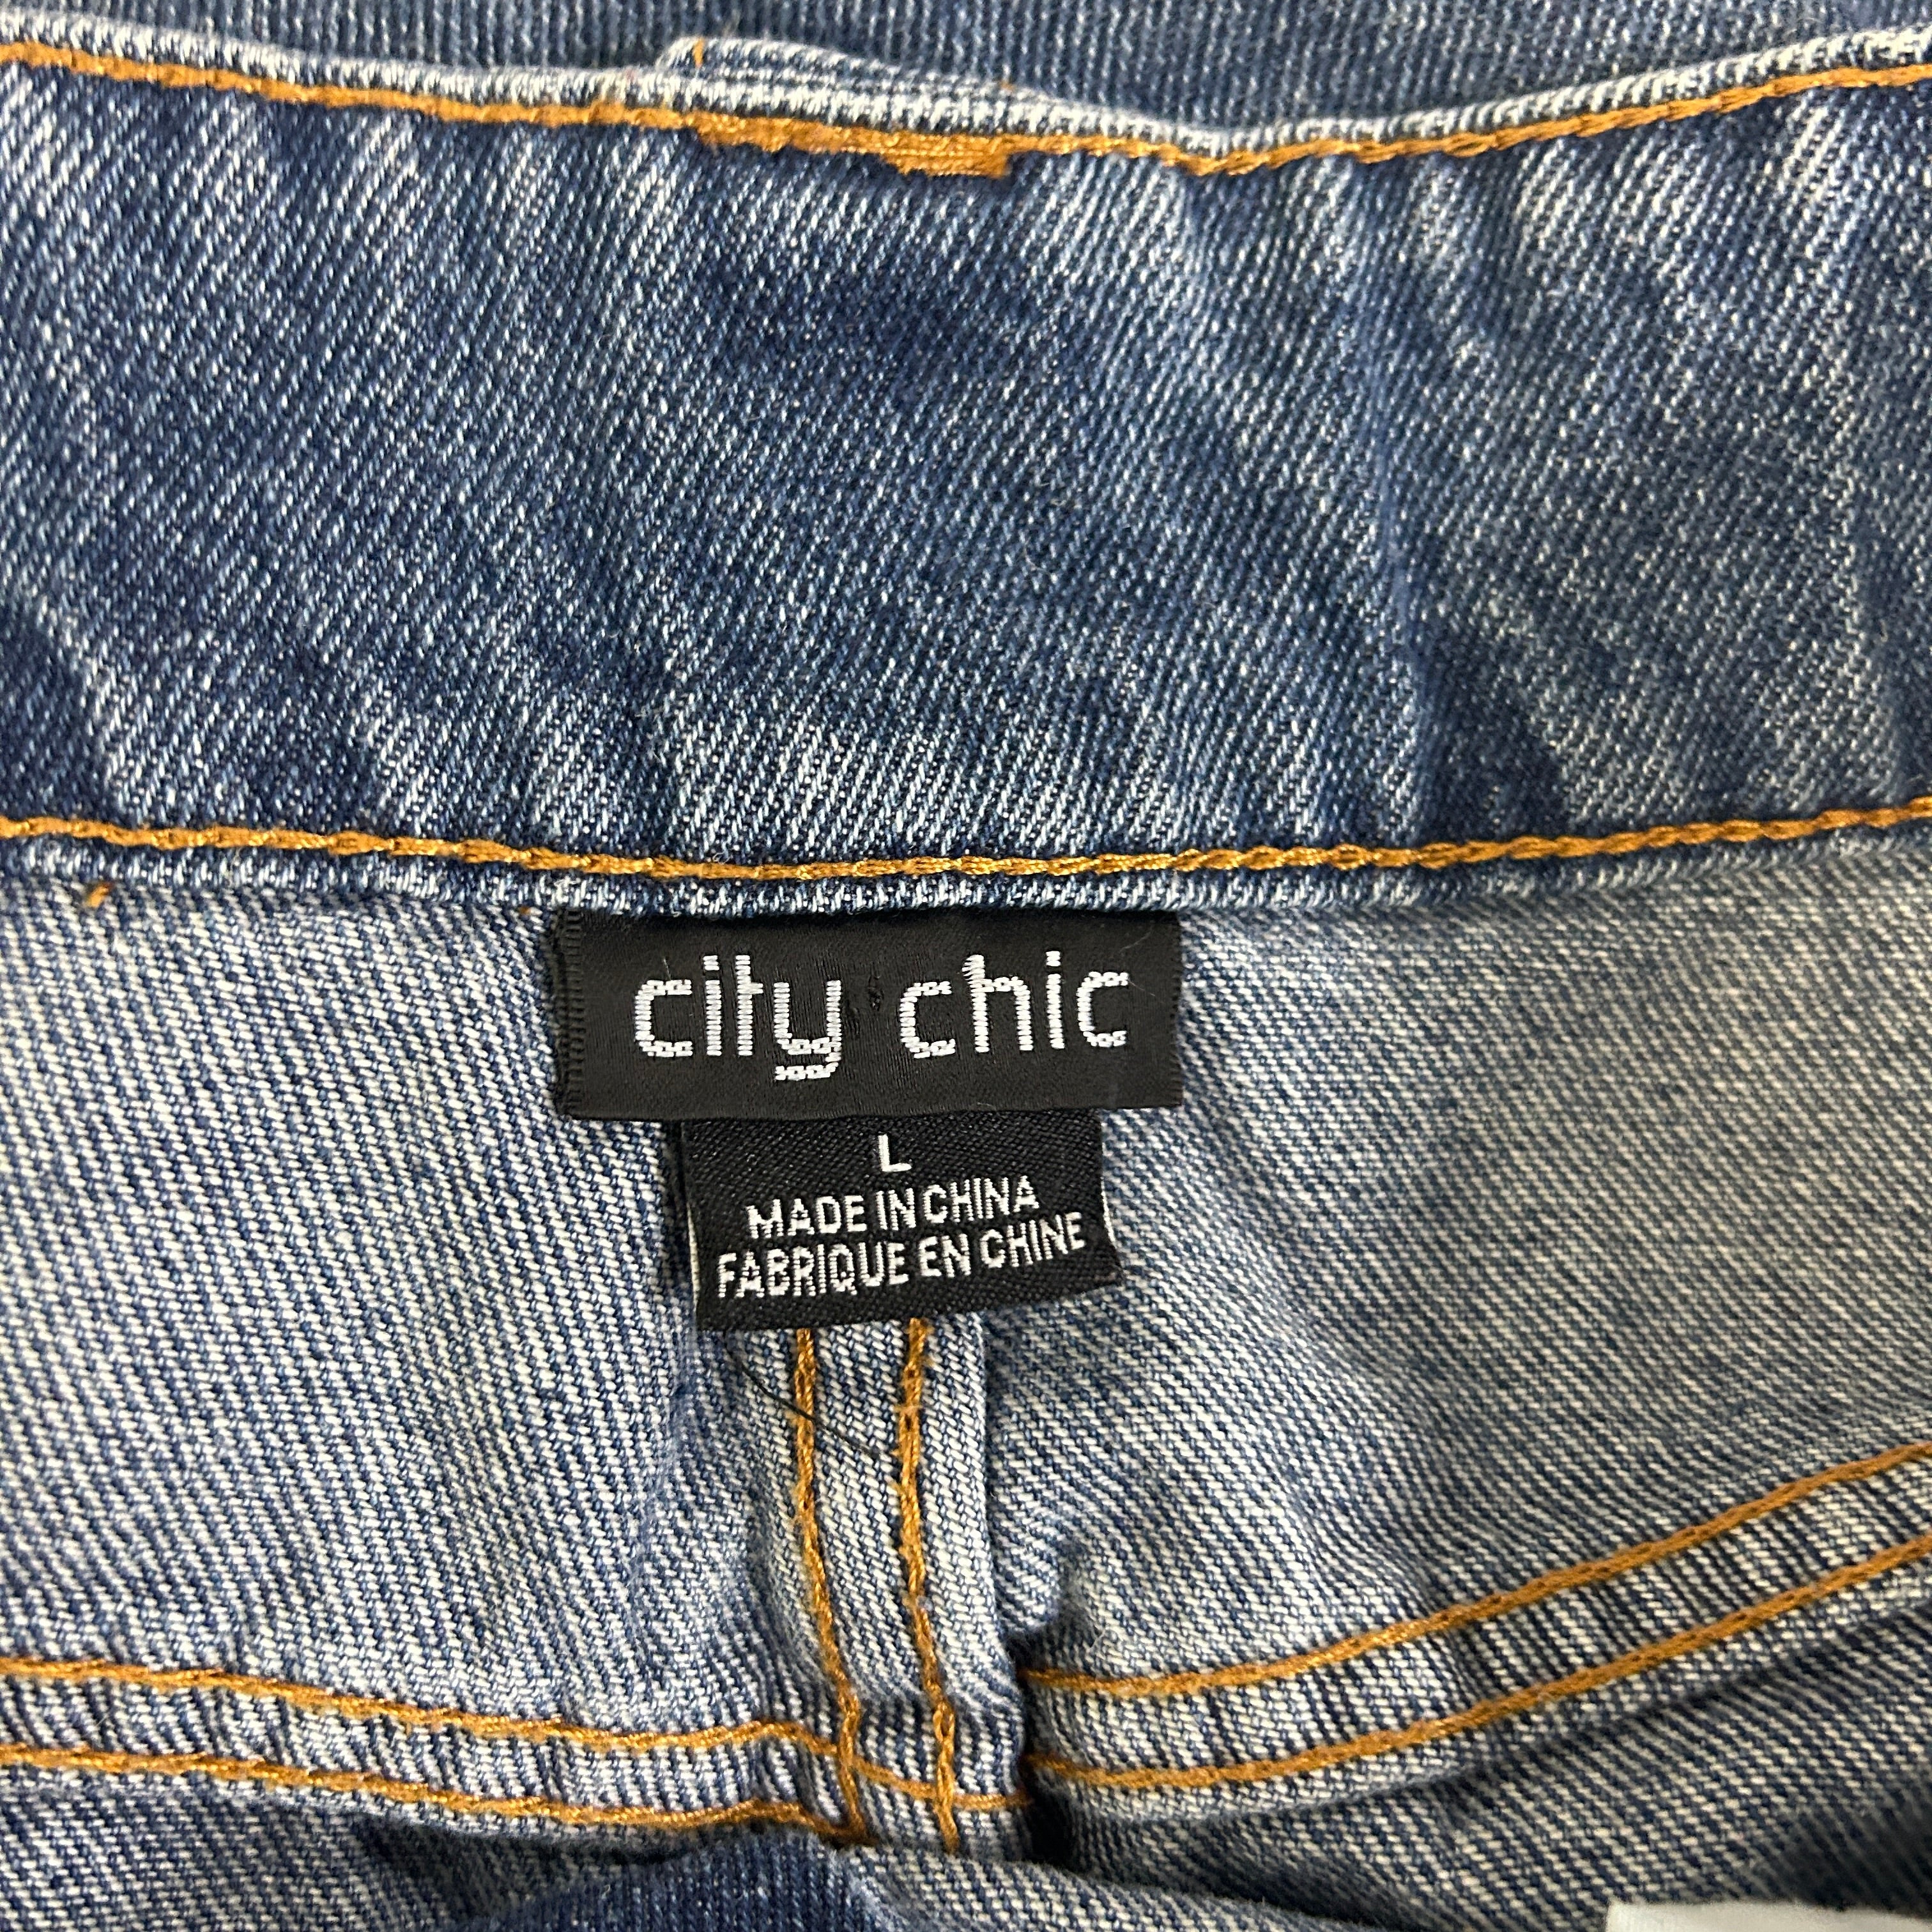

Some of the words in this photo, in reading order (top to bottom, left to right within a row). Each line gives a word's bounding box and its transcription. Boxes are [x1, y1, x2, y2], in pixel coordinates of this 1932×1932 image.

[635, 954, 841, 1080] city
[899, 951, 1129, 1058] chic
[878, 1134, 912, 1172] L
[746, 1195, 867, 1239] MADE
[875, 1188, 916, 1231] IN
[921, 1175, 1039, 1223] CHINA
[716, 1243, 910, 1298] FABRIQUE
[919, 1234, 972, 1278] EN
[979, 1212, 1086, 1269] CHINE
